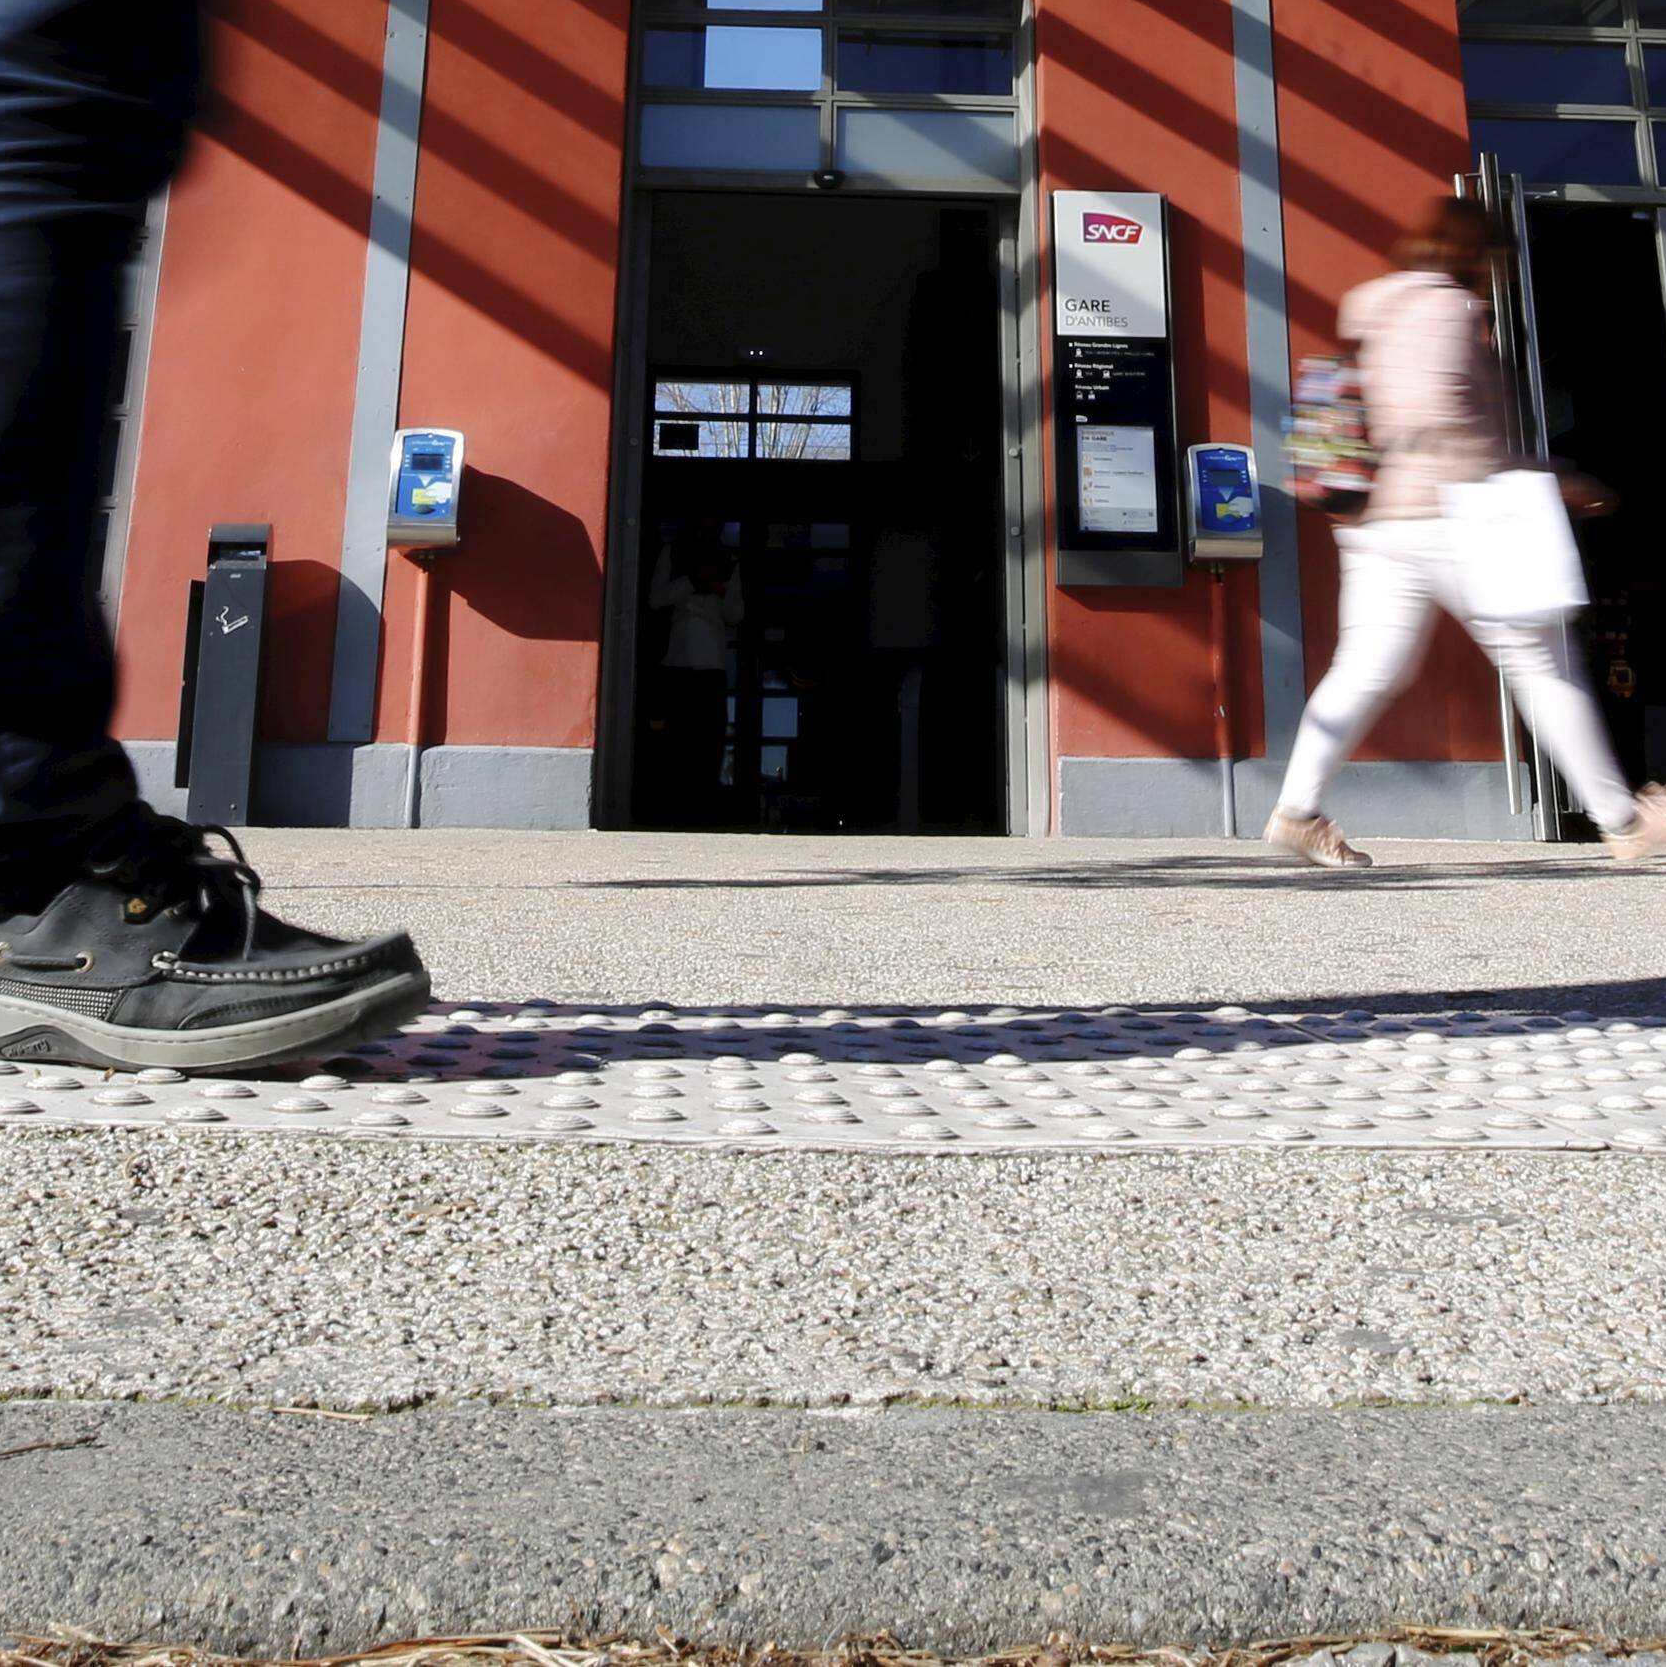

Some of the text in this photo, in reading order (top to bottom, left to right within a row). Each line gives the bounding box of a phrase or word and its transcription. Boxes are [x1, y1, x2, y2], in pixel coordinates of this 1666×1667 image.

[1085, 224, 1140, 241] SNCF
[1065, 298, 1112, 313] GARE
[1065, 315, 1129, 328] D'ANTIBES
